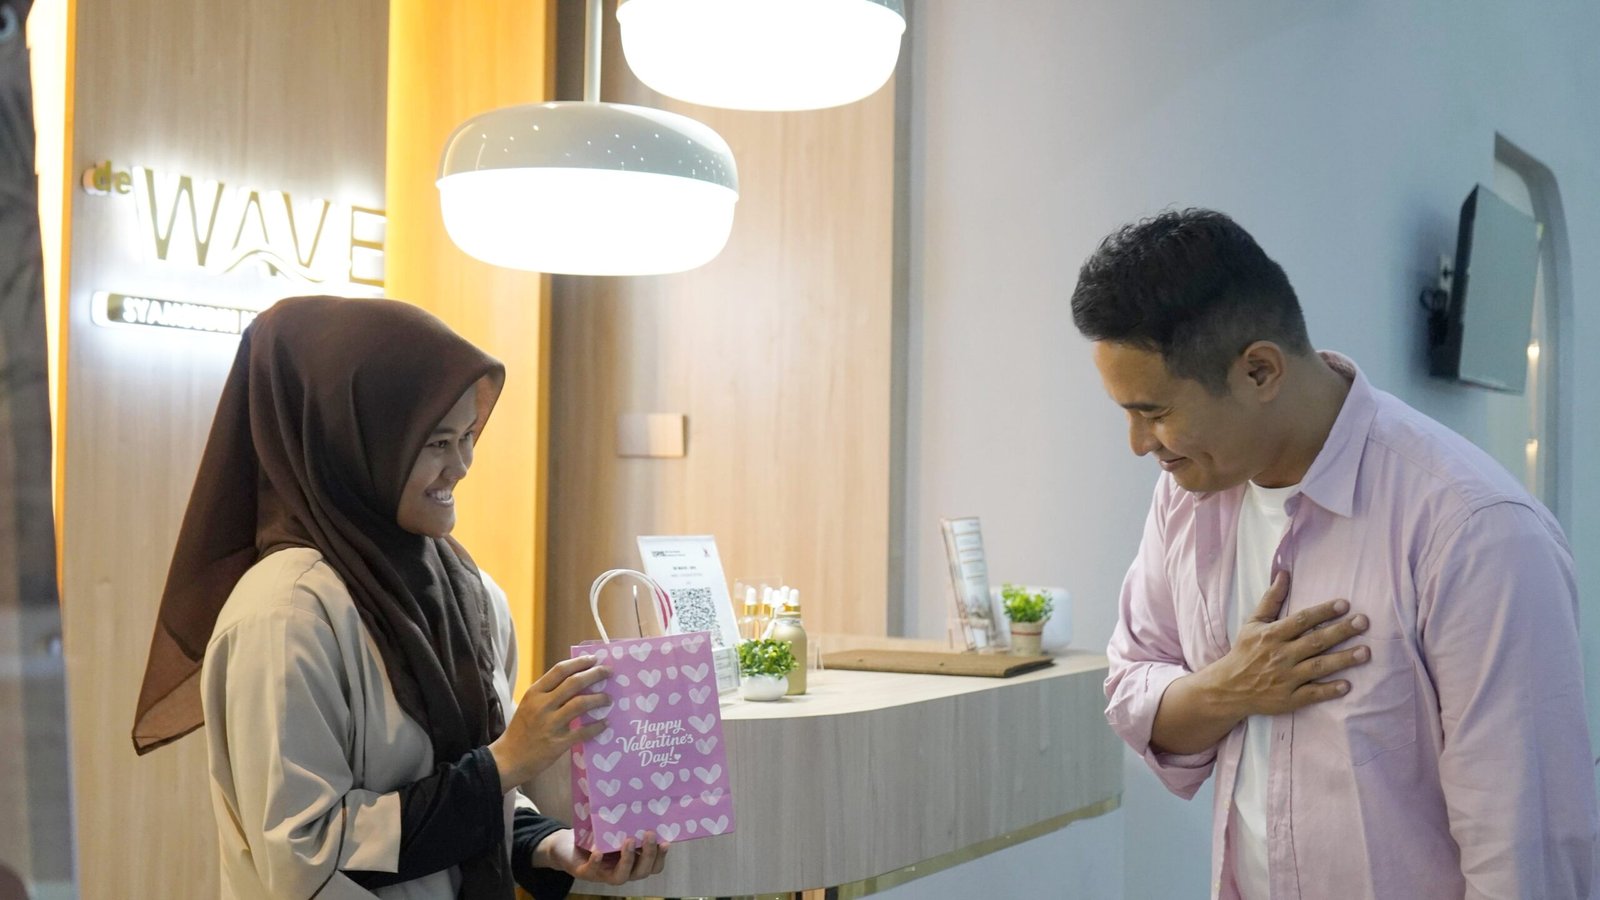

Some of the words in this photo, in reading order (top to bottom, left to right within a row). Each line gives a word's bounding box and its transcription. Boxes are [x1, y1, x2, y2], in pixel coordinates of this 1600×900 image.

[91, 160, 132, 194] de
[143, 168, 387, 288] WAVE
[629, 719, 686, 735] Happy
[615, 733, 694, 753] Valentine's
[638, 746, 679, 768] Day!
